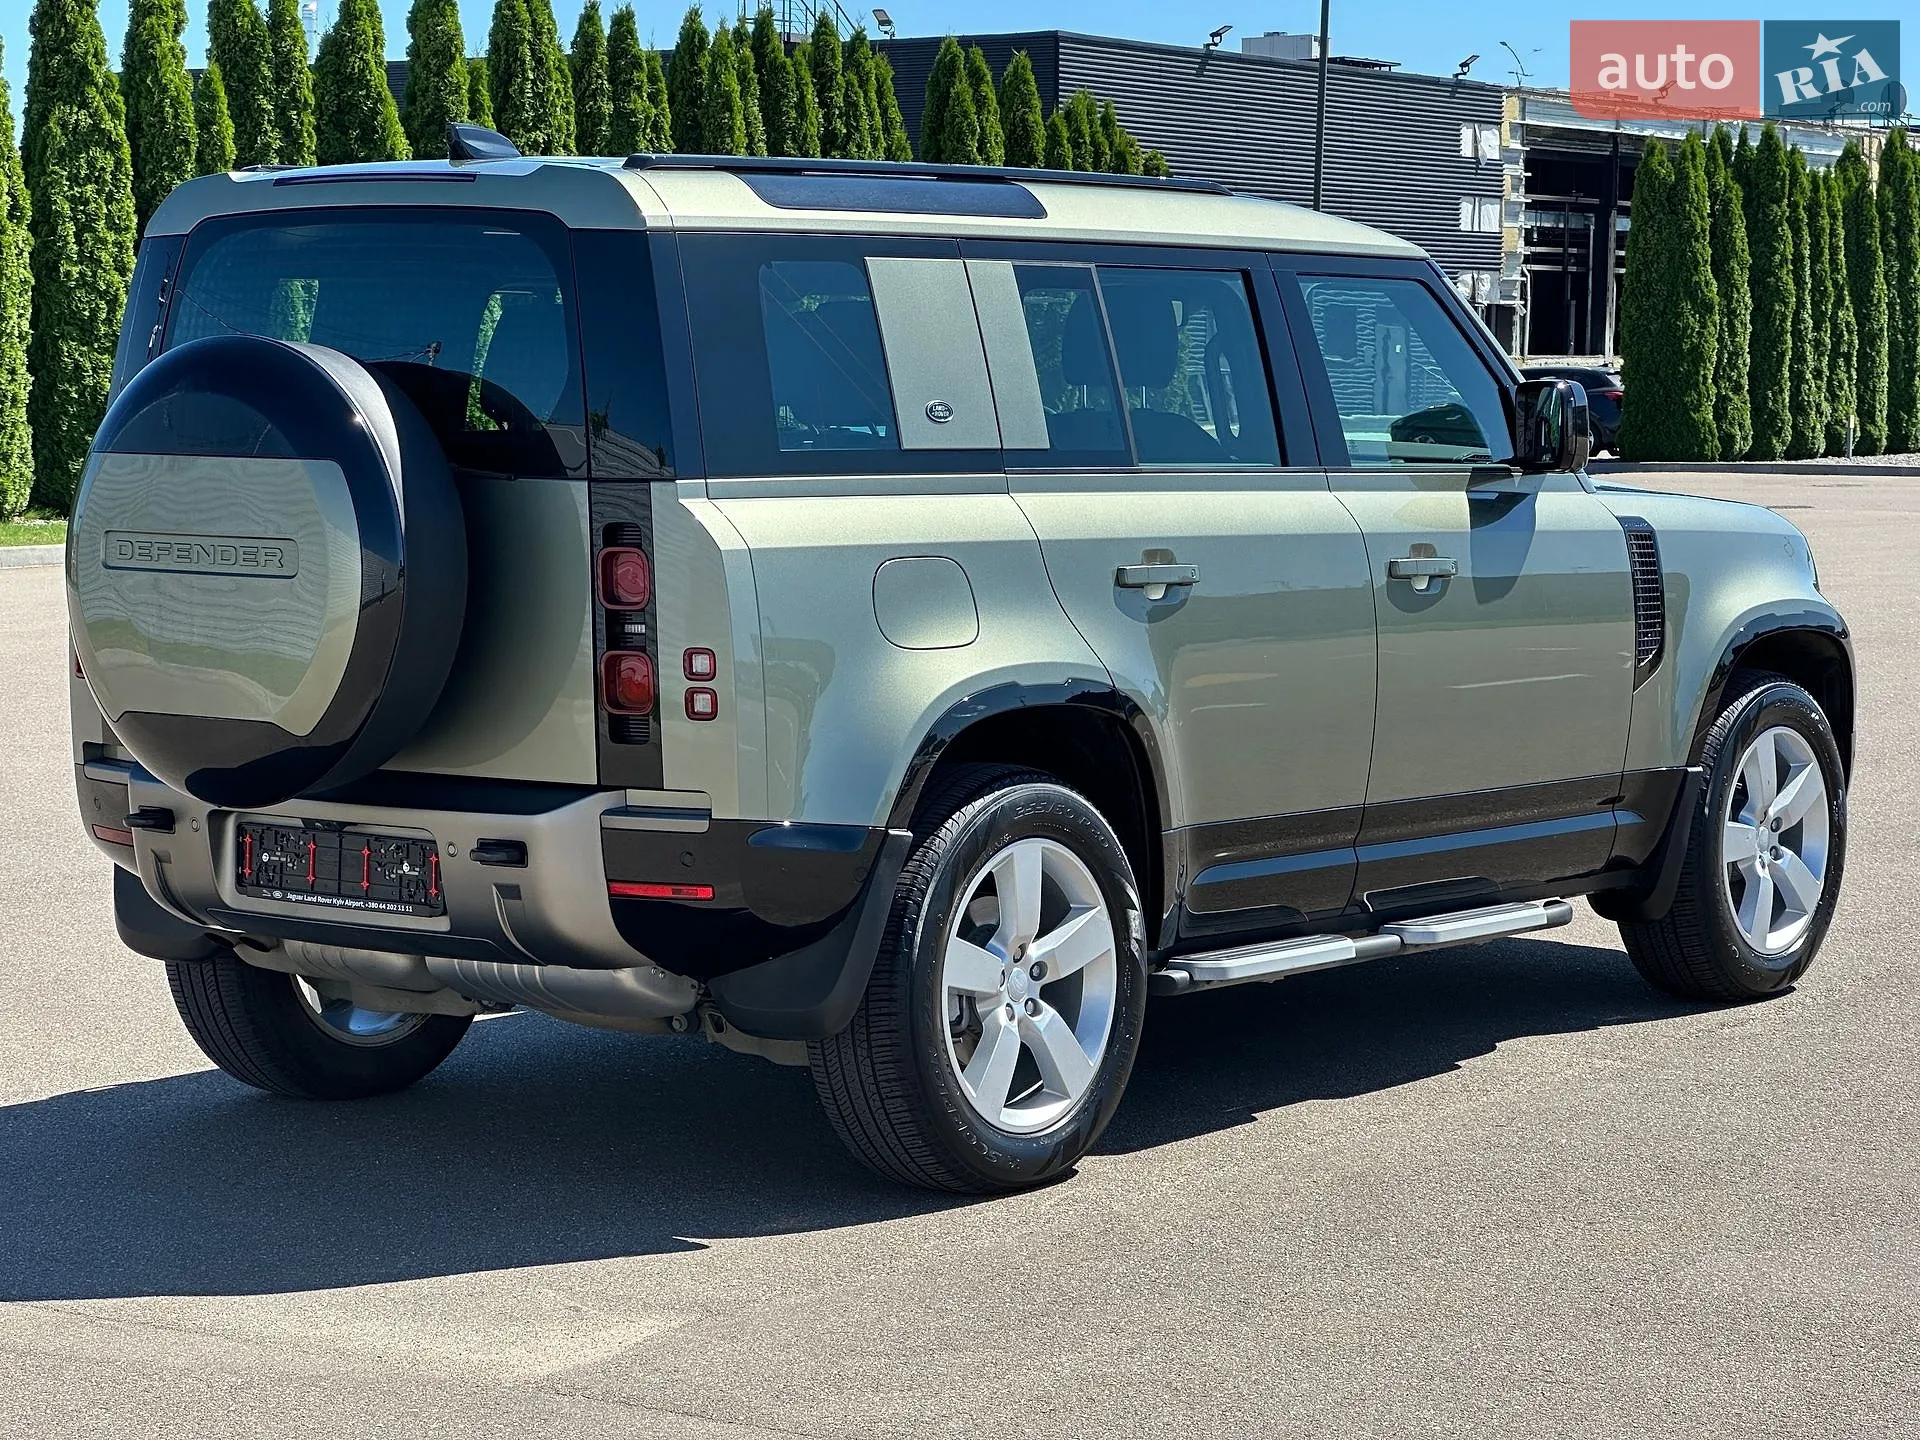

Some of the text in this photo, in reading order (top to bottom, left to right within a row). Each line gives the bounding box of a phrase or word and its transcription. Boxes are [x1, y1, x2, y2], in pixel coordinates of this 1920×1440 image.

[116, 540, 284, 568] DEFENDER
[286, 892, 303, 901] Jaguar
[304, 894, 317, 903] Land
[318, 896, 332, 904] Rover
[332, 897, 345, 907] Kyiv
[365, 901, 379, 909] +380
[387, 903, 397, 911] 202
